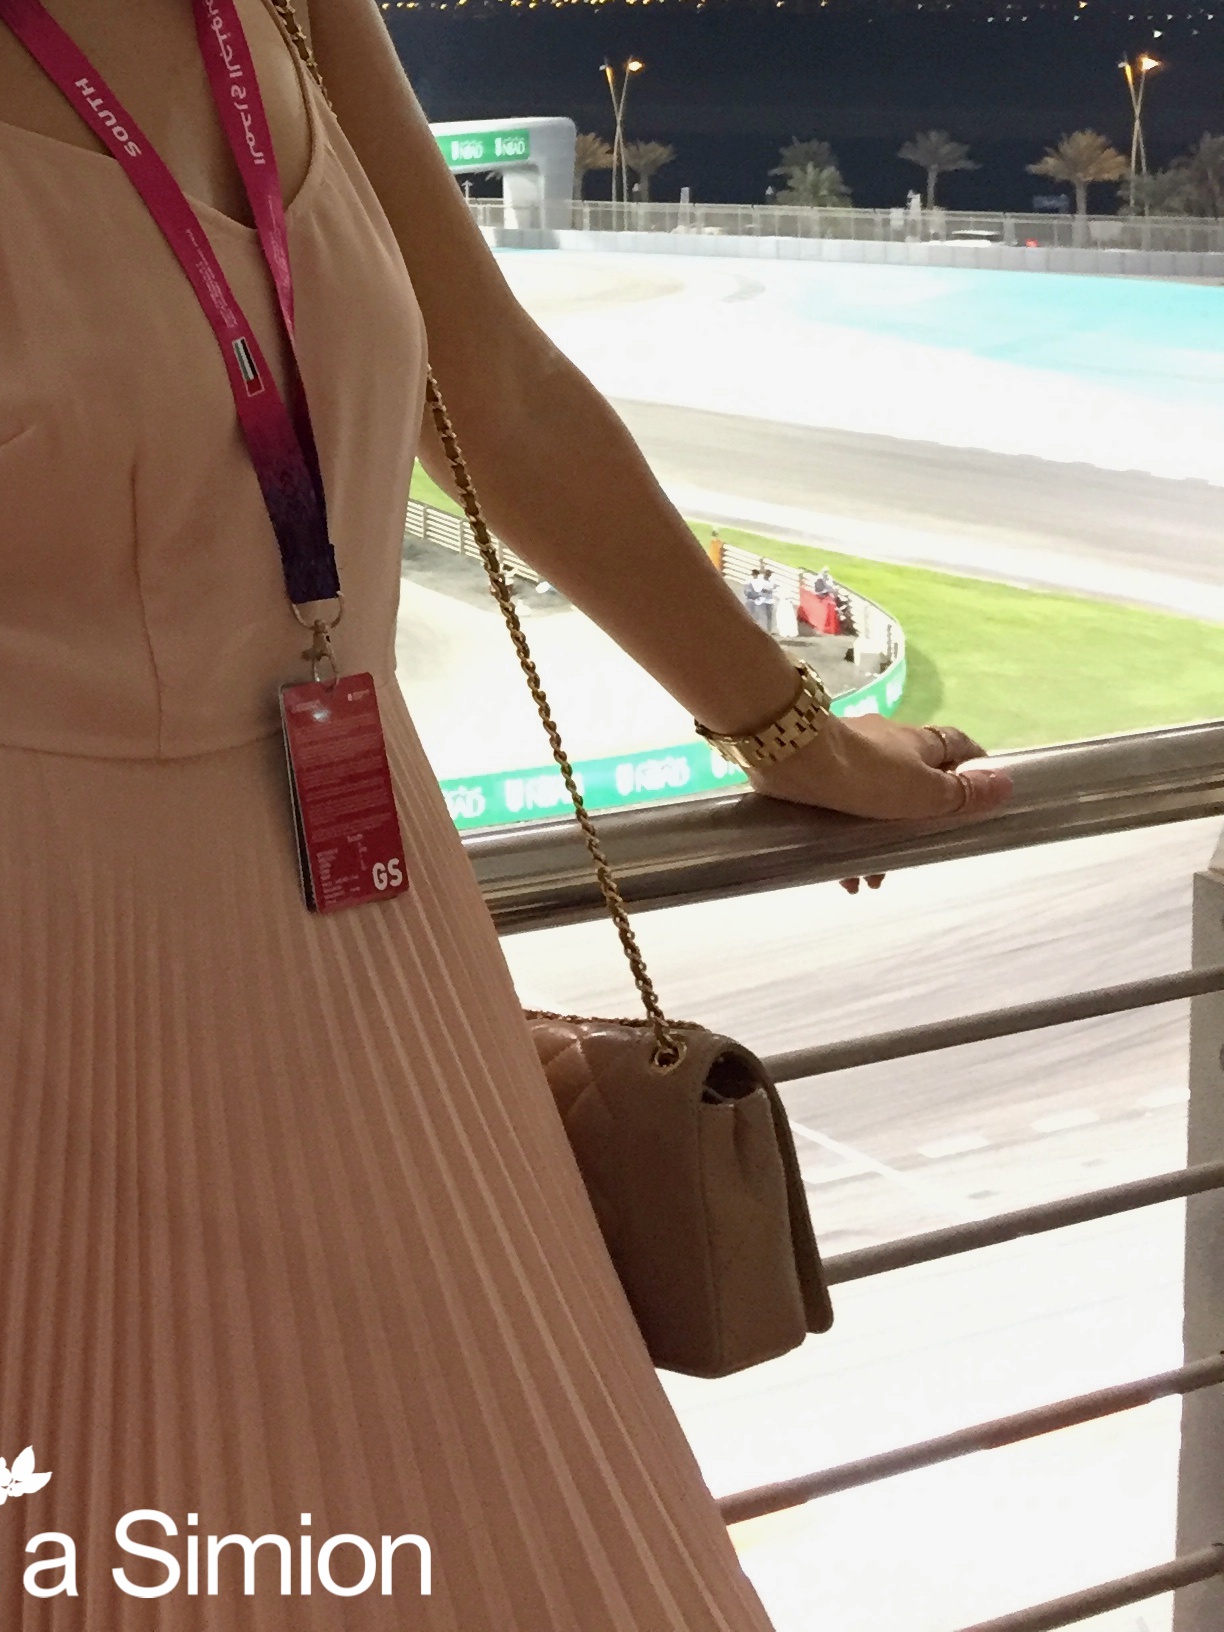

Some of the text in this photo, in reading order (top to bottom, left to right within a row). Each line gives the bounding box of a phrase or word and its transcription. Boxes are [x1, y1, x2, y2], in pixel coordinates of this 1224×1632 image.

[75, 77, 142, 158] SOUTH
[231, 86, 266, 165] المدرج
[372, 857, 403, 891] GS
